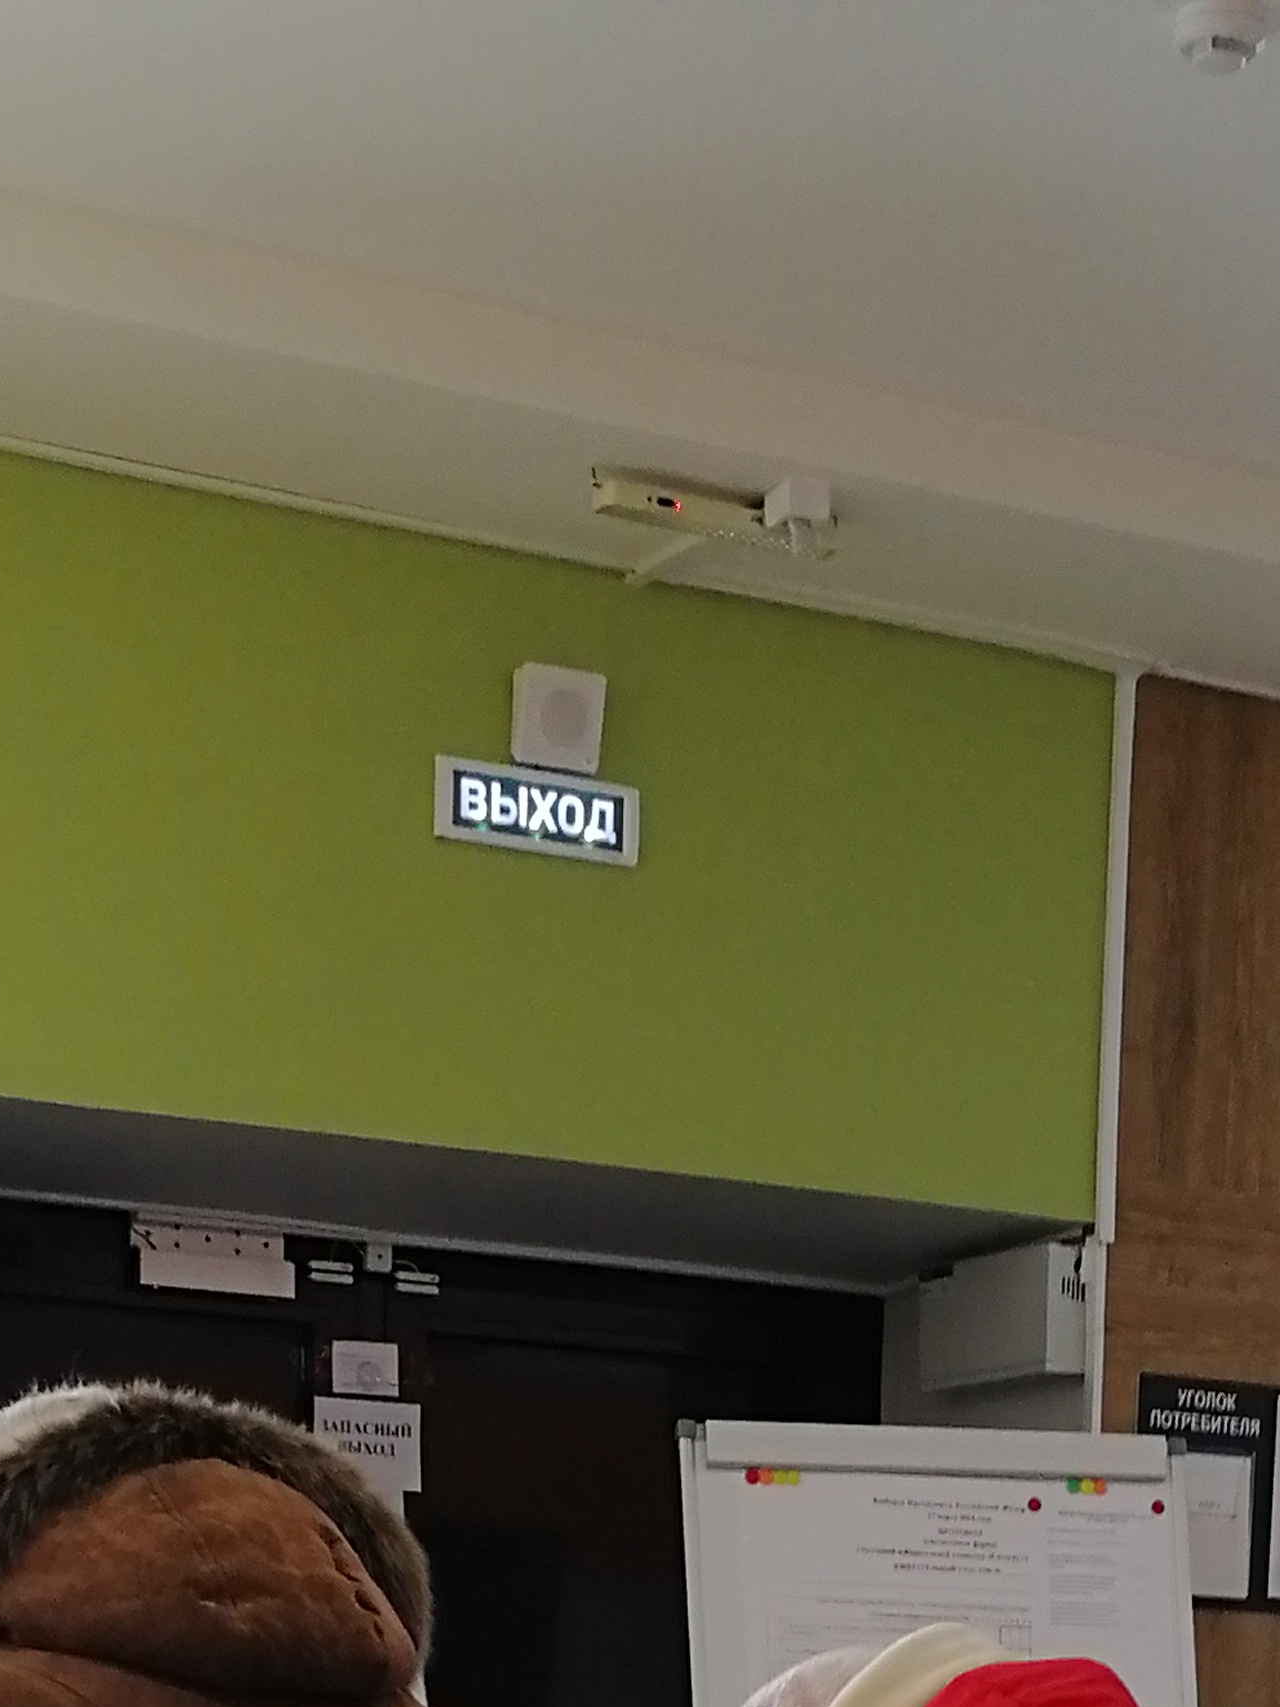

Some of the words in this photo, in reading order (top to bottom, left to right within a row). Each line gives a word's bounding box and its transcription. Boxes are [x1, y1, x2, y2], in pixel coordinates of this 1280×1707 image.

[460, 777, 617, 846] ВЫХОД
[1177, 1387, 1238, 1412] УГОЛОК
[323, 1419, 413, 1439] ЗАПАСНЫЙ
[1149, 1408, 1261, 1439] ПОТРЕБИТЕЛЯ
